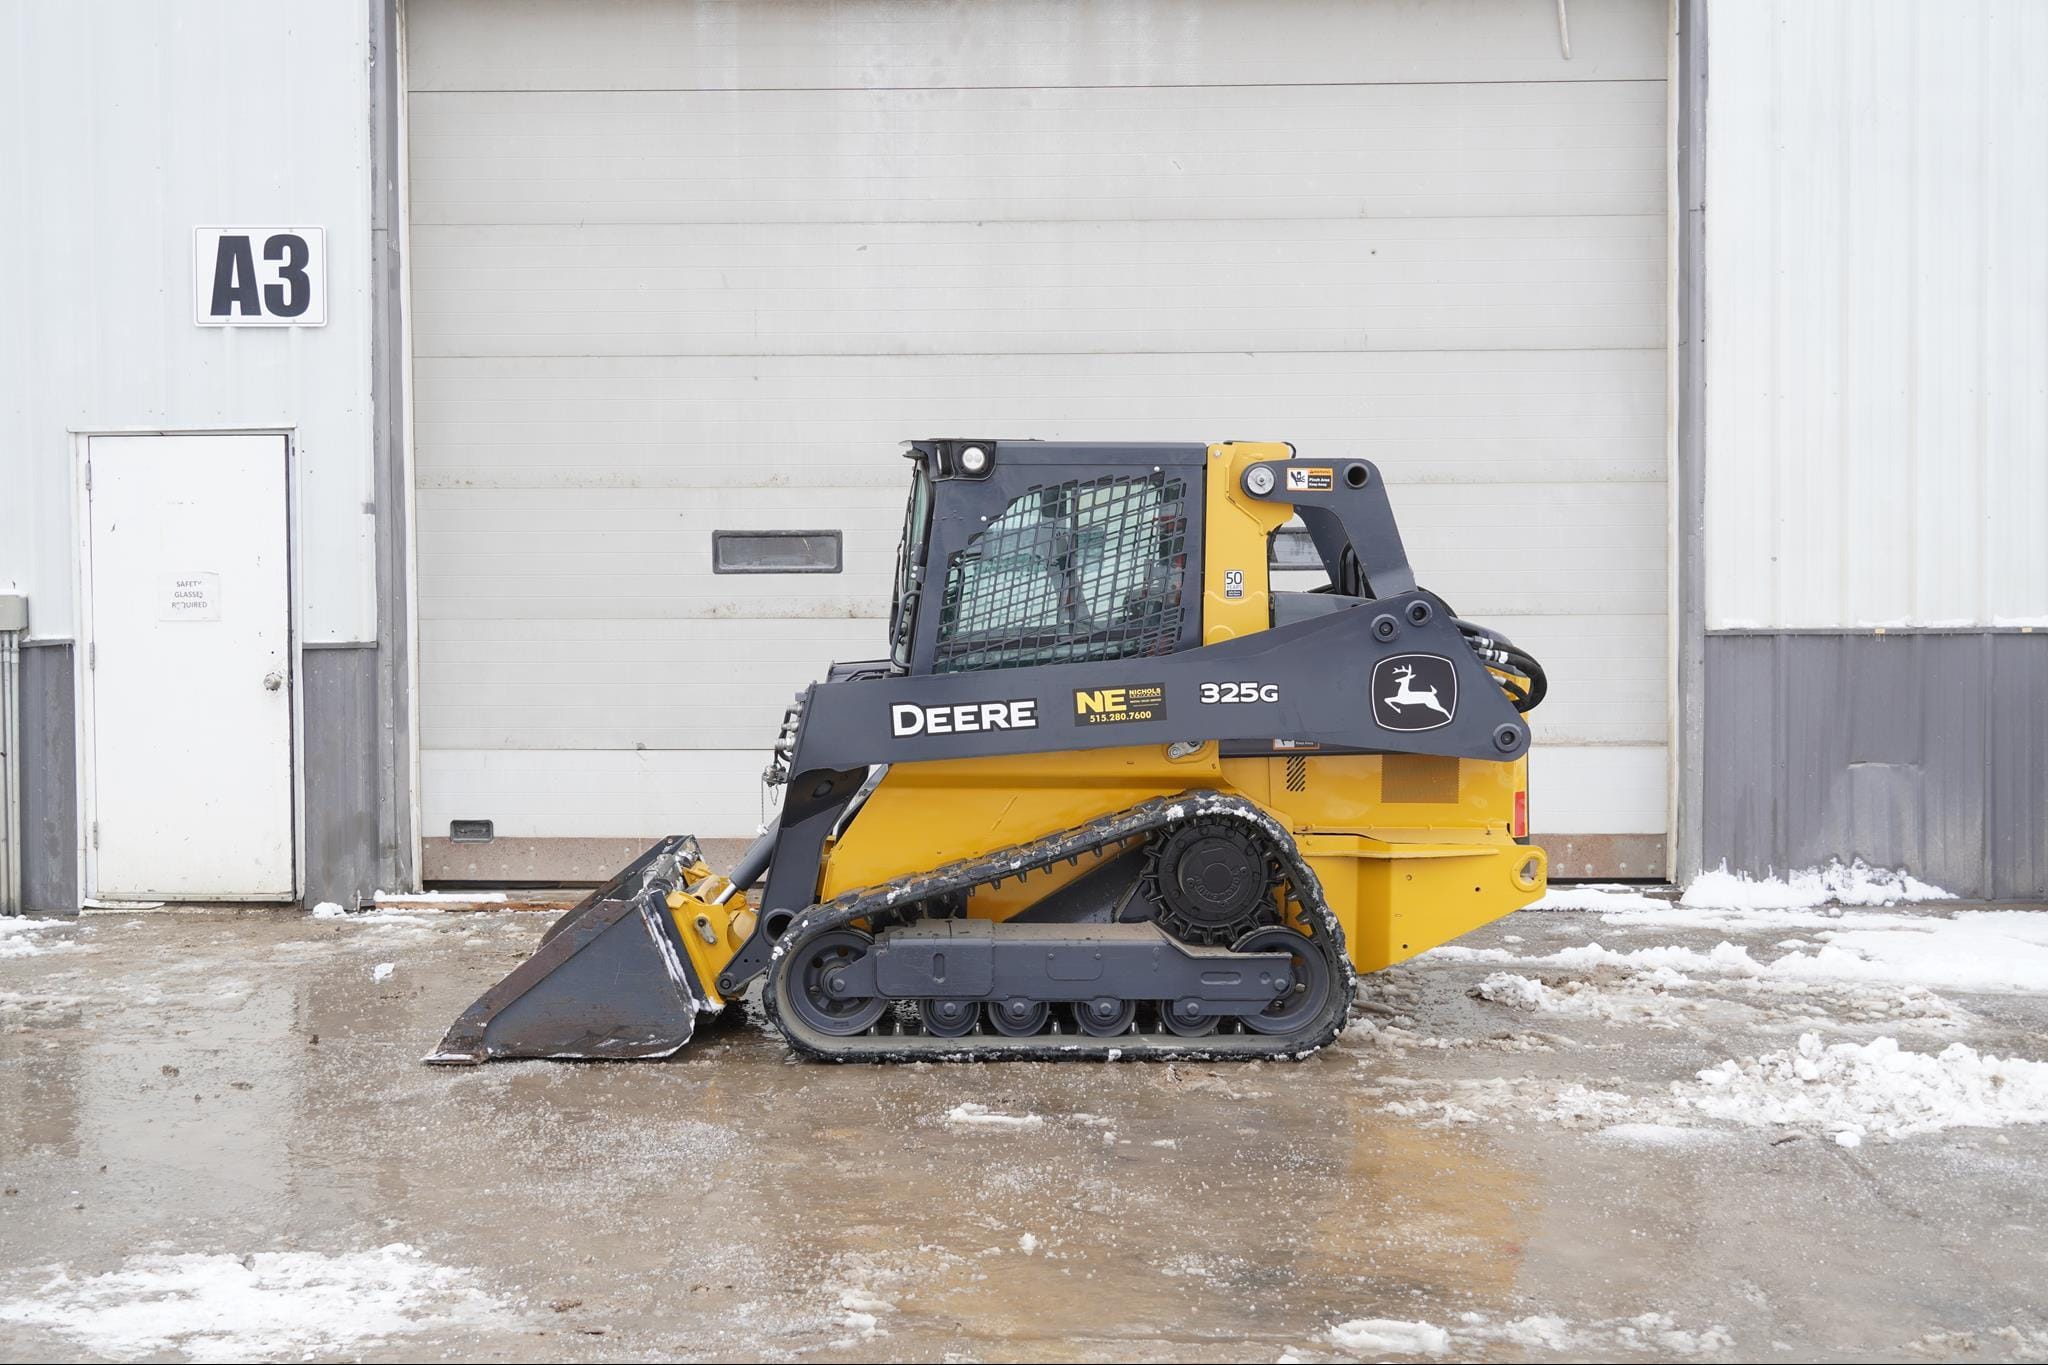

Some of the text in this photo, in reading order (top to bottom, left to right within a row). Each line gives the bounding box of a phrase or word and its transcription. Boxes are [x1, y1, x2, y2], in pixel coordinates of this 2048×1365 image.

[209, 233, 311, 318] A3
[1226, 571, 1242, 585] 50
[171, 601, 208, 609] RUIRED
[1128, 687, 1161, 695] NICHOLS
[1200, 682, 1279, 703] 325G
[1076, 689, 1127, 713] NE
[892, 701, 1036, 736] DEERE
[1089, 710, 1152, 723] 515.280.7600
